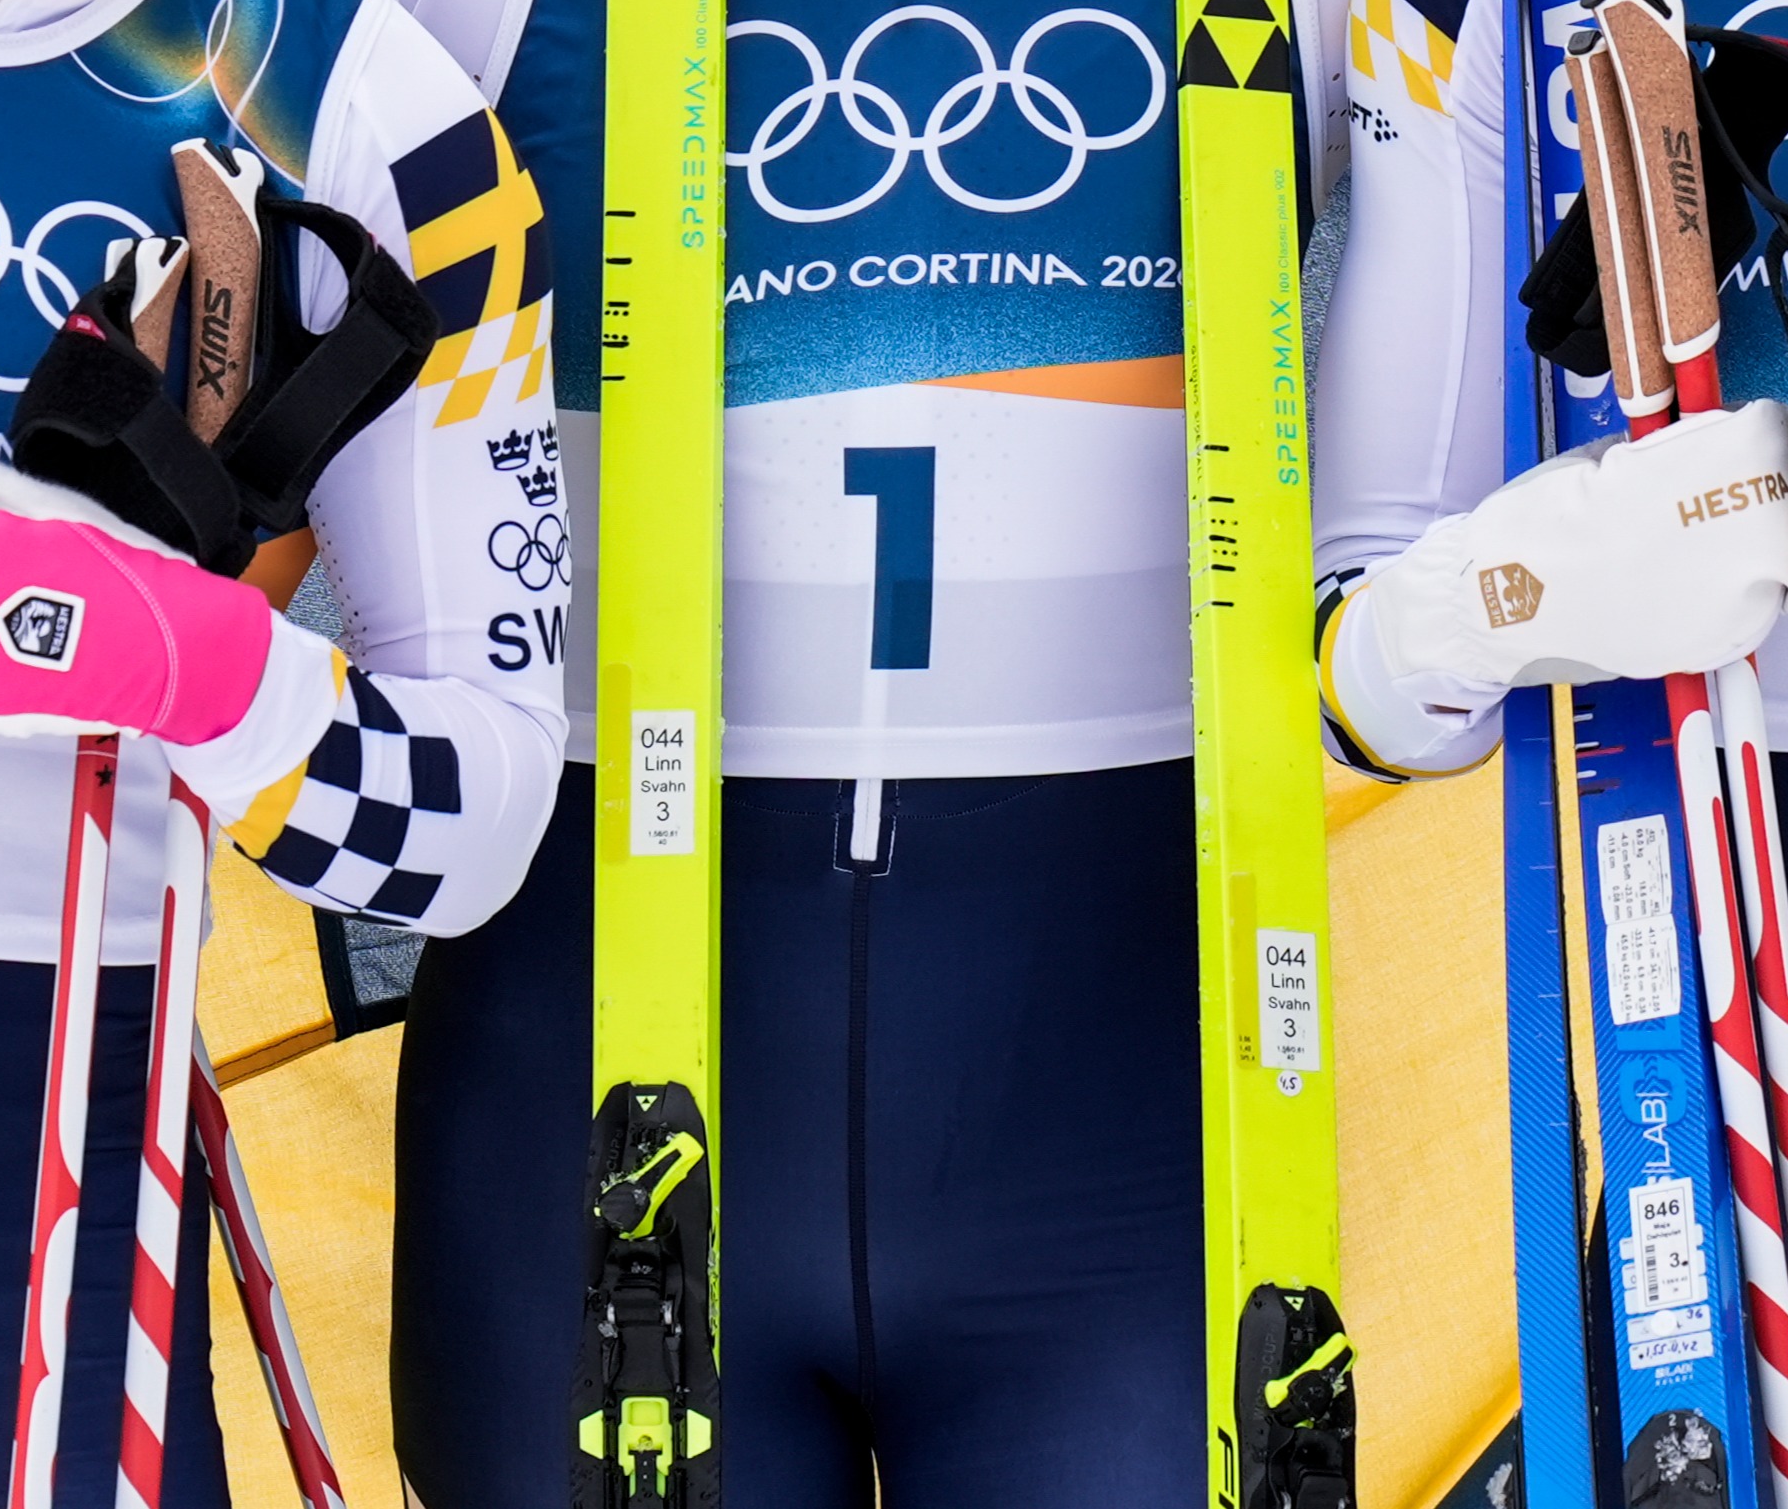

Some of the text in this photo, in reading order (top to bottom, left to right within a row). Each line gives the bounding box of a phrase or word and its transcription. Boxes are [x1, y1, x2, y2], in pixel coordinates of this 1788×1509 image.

[681, 56, 707, 250] SPEEDMAX
[848, 253, 1088, 287] CORTINA
[1101, 255, 1183, 289] 202
[1269, 298, 1300, 486] SPEEDMAX
[844, 446, 936, 670] 1
[1483, 572, 1503, 627] HESTRA
[49, 606, 71, 655] HESTRA
[641, 728, 684, 749] 044
[645, 756, 682, 772] Linn
[641, 779, 686, 794] Svahn
[656, 801, 670, 822] 3
[1266, 946, 1307, 968] 044
[1271, 973, 1306, 990] Linn
[1268, 996, 1311, 1012] Svahn
[1284, 1019, 1297, 1038] 3
[1644, 1199, 1680, 1220] 846
